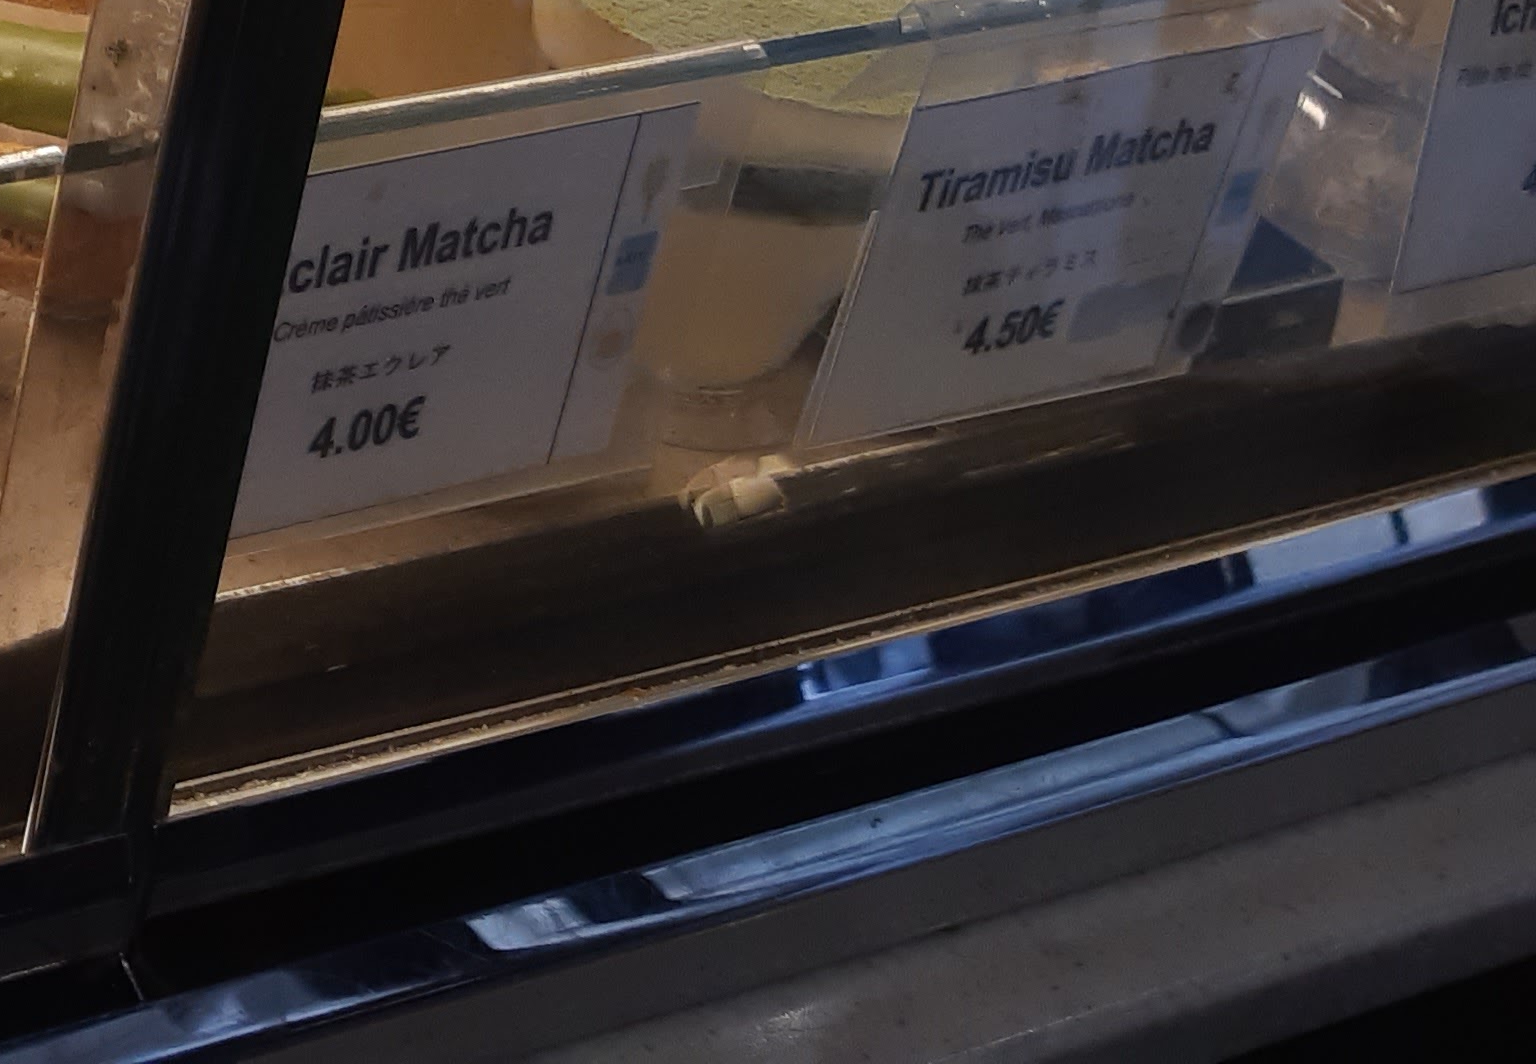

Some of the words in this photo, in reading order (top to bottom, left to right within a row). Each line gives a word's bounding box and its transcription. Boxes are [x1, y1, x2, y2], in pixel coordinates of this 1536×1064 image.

[918, 147, 1078, 212] Tiramisu
[1085, 118, 1216, 176] Matcha
[282, 237, 389, 293] clair
[397, 207, 554, 272] Matcha
[475, 275, 511, 300] vert
[962, 298, 1065, 356] 4.50€
[308, 395, 426, 459] 4.00€
